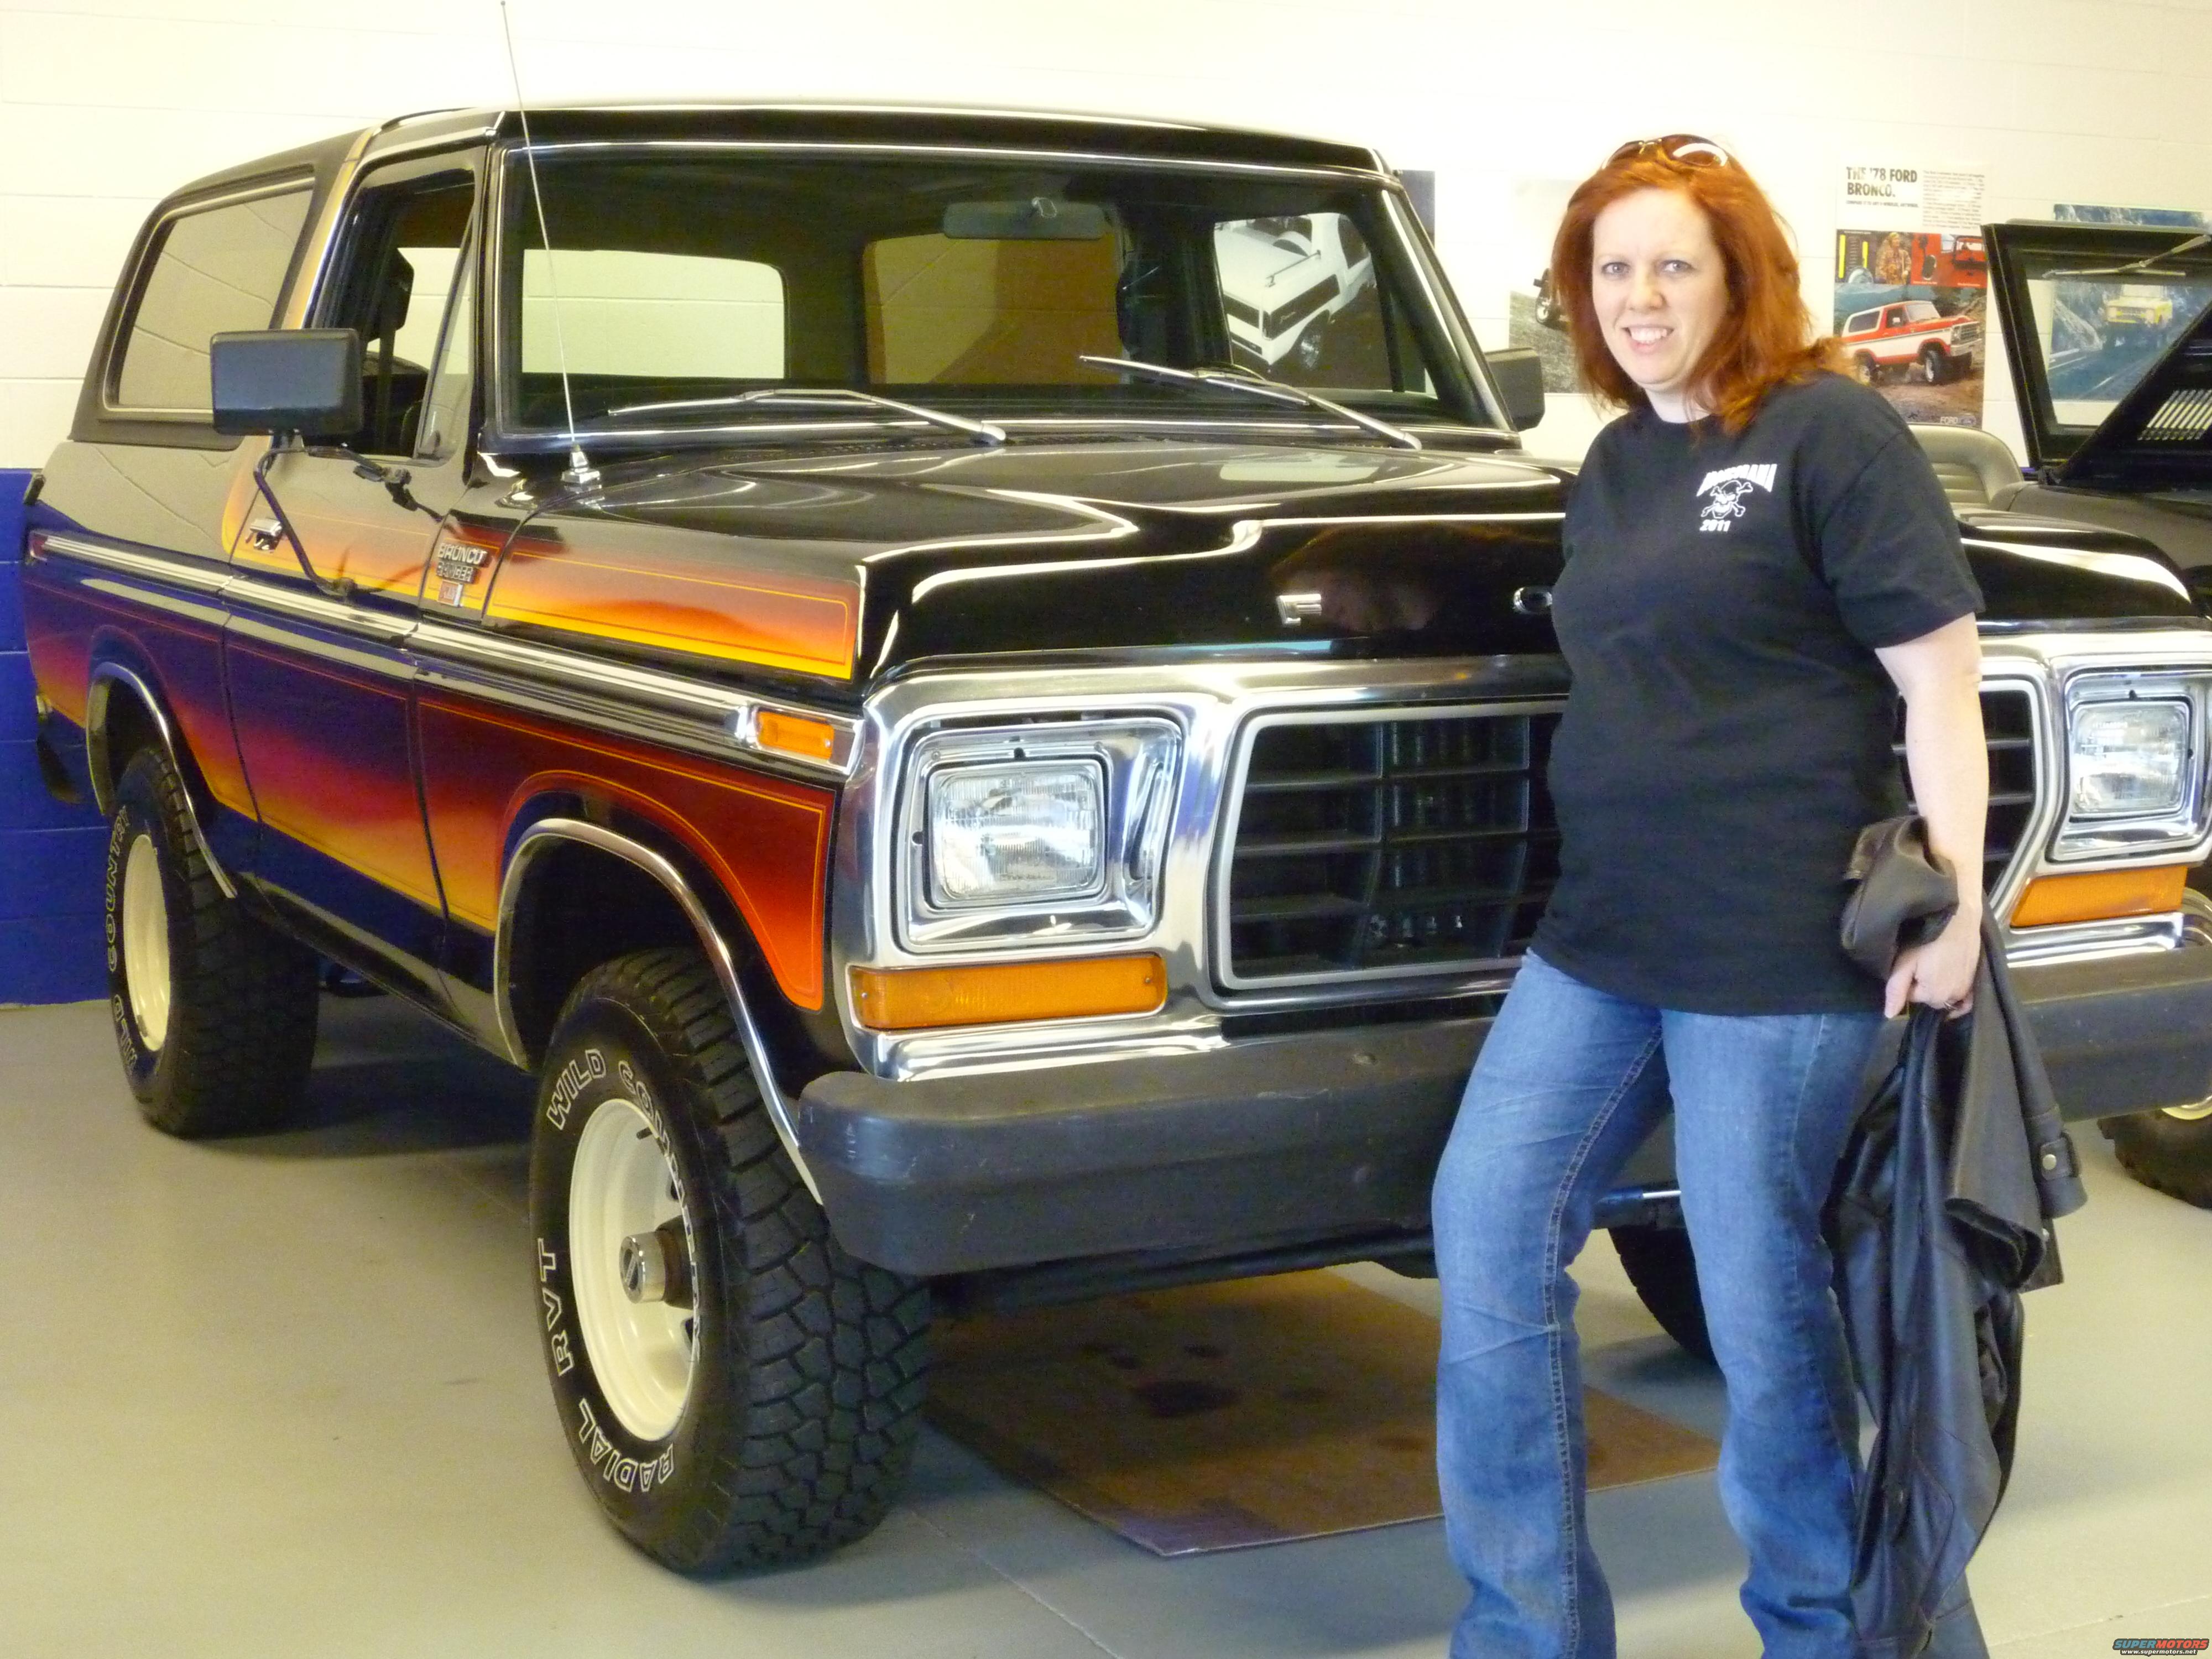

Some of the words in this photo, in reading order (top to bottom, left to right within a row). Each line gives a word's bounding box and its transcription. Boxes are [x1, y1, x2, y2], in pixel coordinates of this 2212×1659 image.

[1846, 166, 1866, 180] THE
[1890, 169, 1918, 183] FORD
[1847, 182, 1896, 197] BRONCO.
[1940, 416, 1958, 425] FORD
[1699, 519, 1731, 531] 2011
[437, 542, 488, 565] BRONCO
[437, 561, 473, 582] RANGER
[546, 1048, 607, 1130] WILD
[538, 1237, 575, 1377] RVT
[578, 1397, 674, 1493] RADIAL
